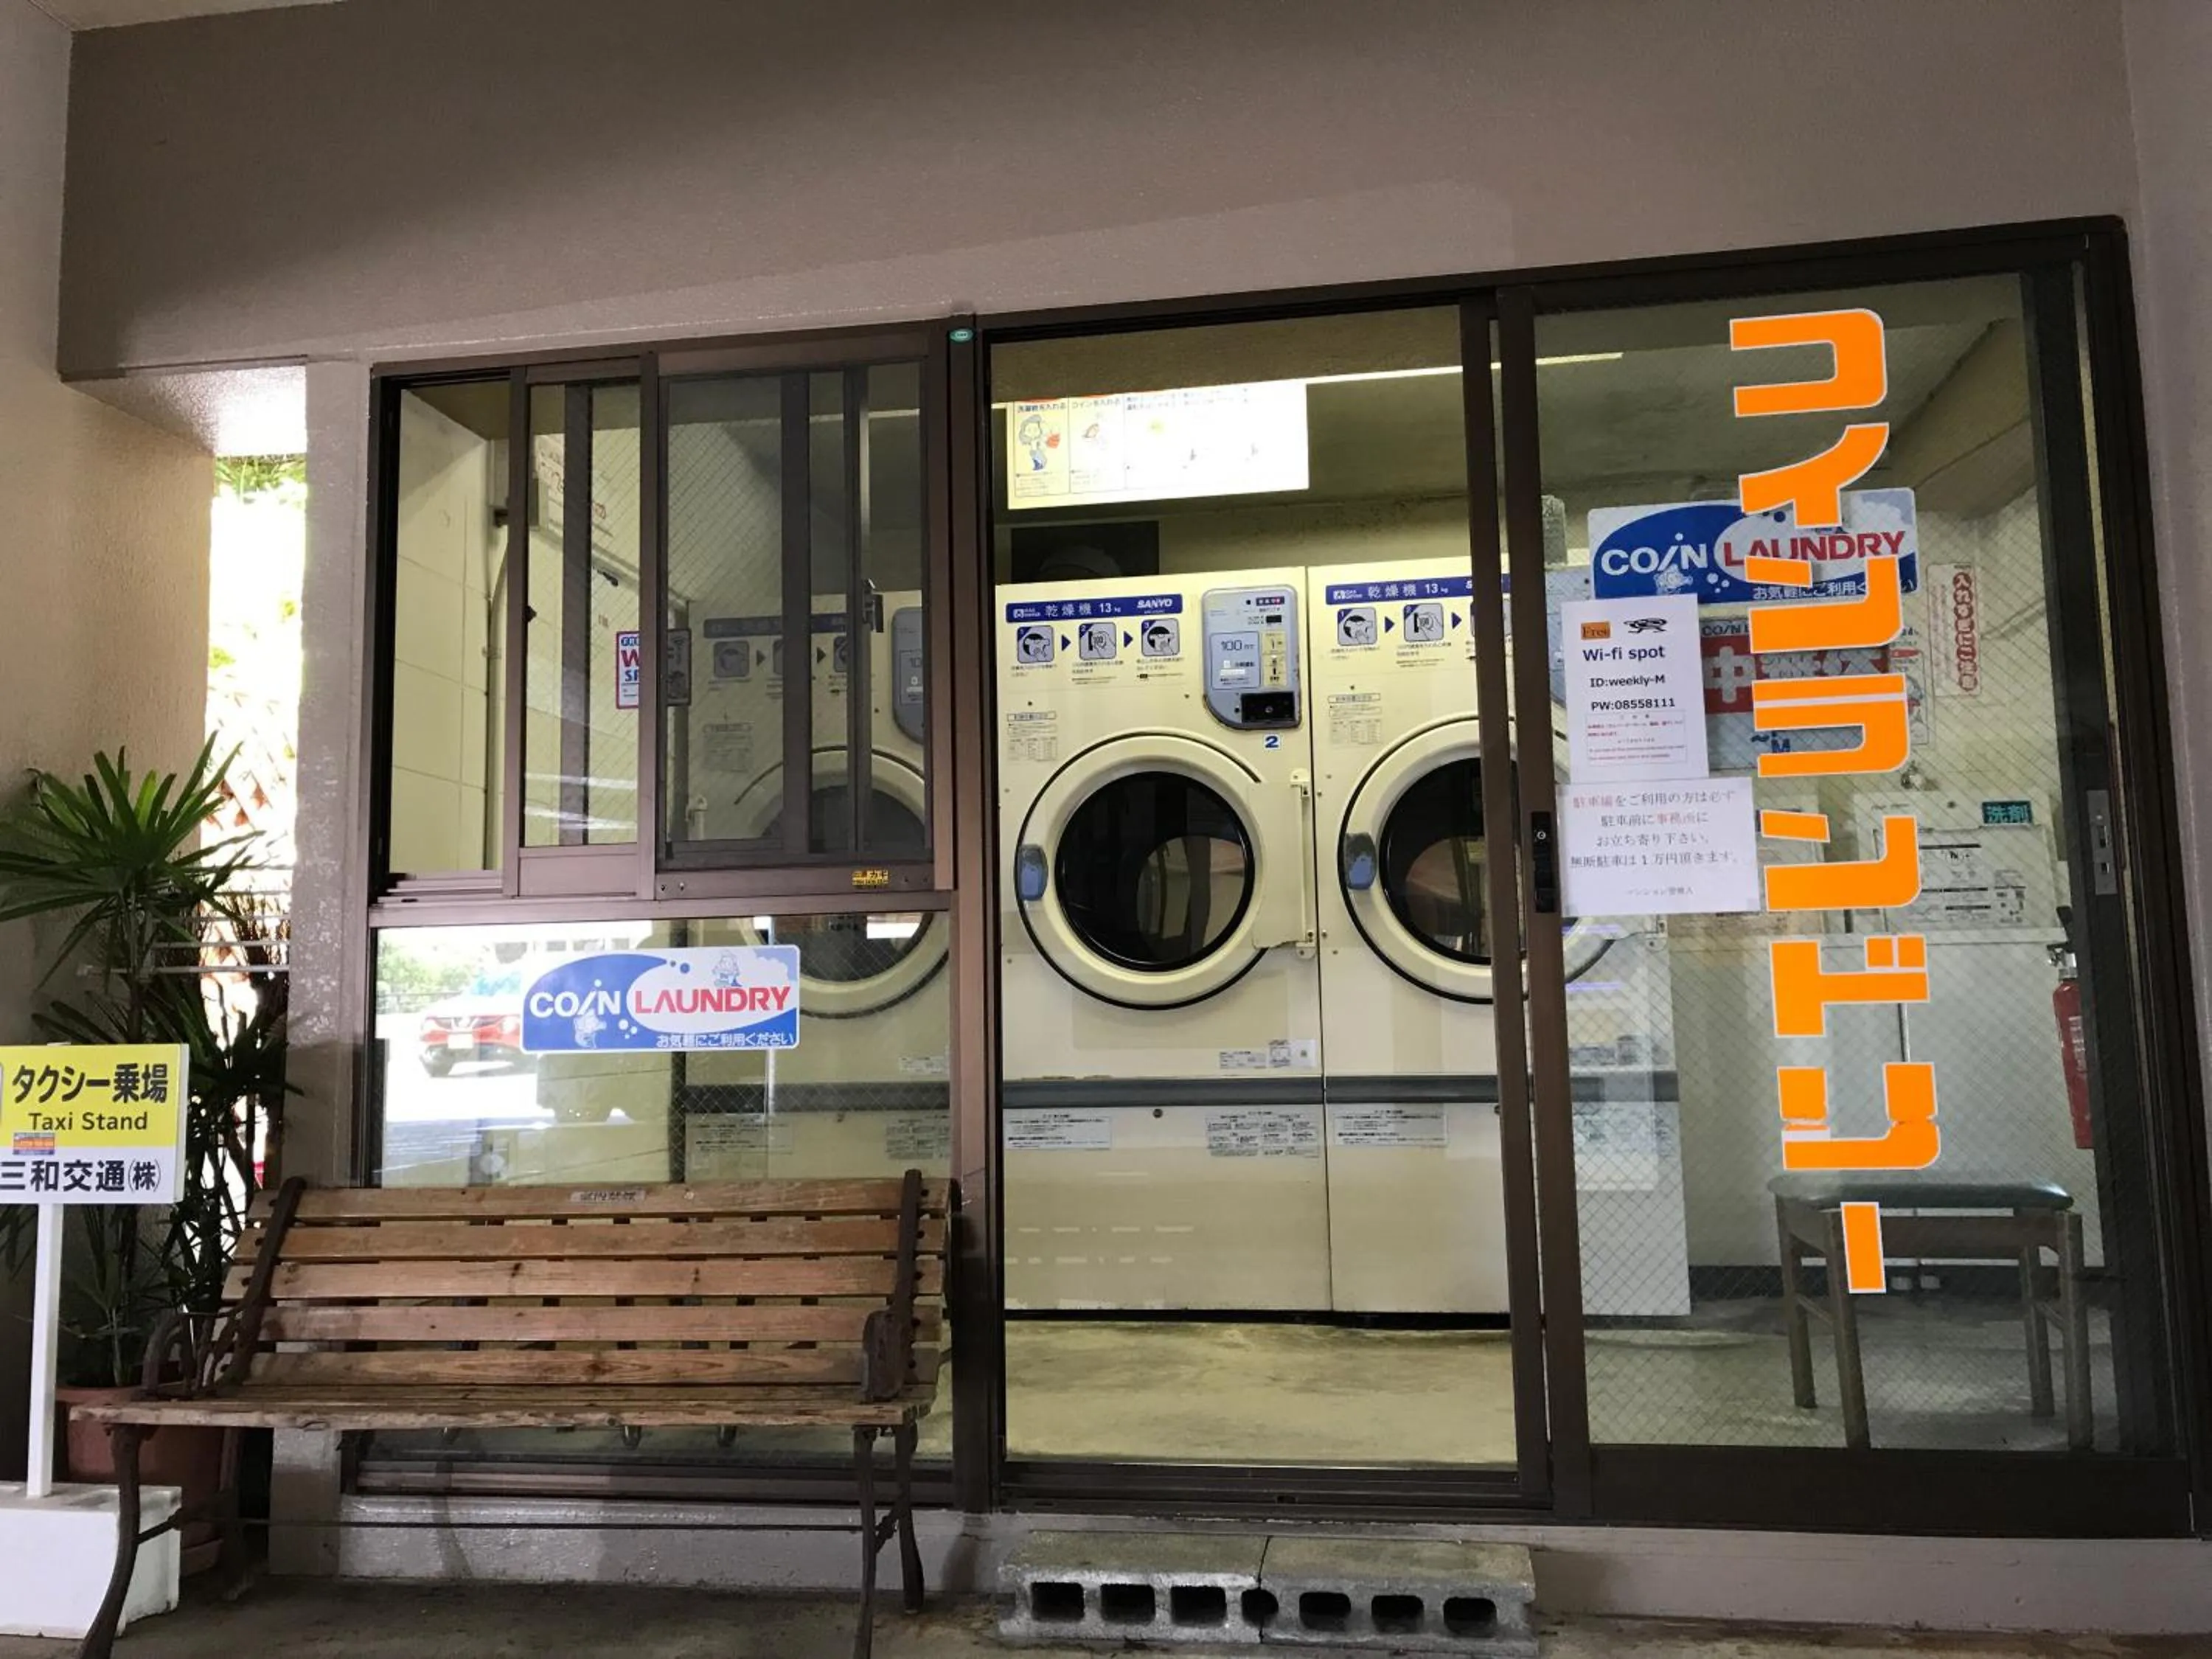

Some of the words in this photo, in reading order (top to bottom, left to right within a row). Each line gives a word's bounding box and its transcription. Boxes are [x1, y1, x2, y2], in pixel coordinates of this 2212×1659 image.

[1601, 534, 1707, 576] COIN
[1723, 530, 1905, 567] LAUNDRY
[1753, 579, 1915, 601] お気軽にご利用くい
[1099, 602, 1112, 614] 13
[1136, 598, 1173, 609] SANYO
[1582, 647, 1622, 661] Wi-fi
[1628, 645, 1666, 662] spot
[1590, 674, 1666, 687] ID:weekly-M
[1591, 698, 1675, 711] PW:08558111
[1265, 735, 1279, 748] 2
[1730, 308, 1941, 1293] コインランドリー
[529, 982, 621, 1018] COIN
[635, 986, 791, 1015] LAUNDRY
[12, 1062, 168, 1104] タクシー乗場
[28, 1111, 73, 1131] Taxi
[82, 1111, 147, 1130] Stand
